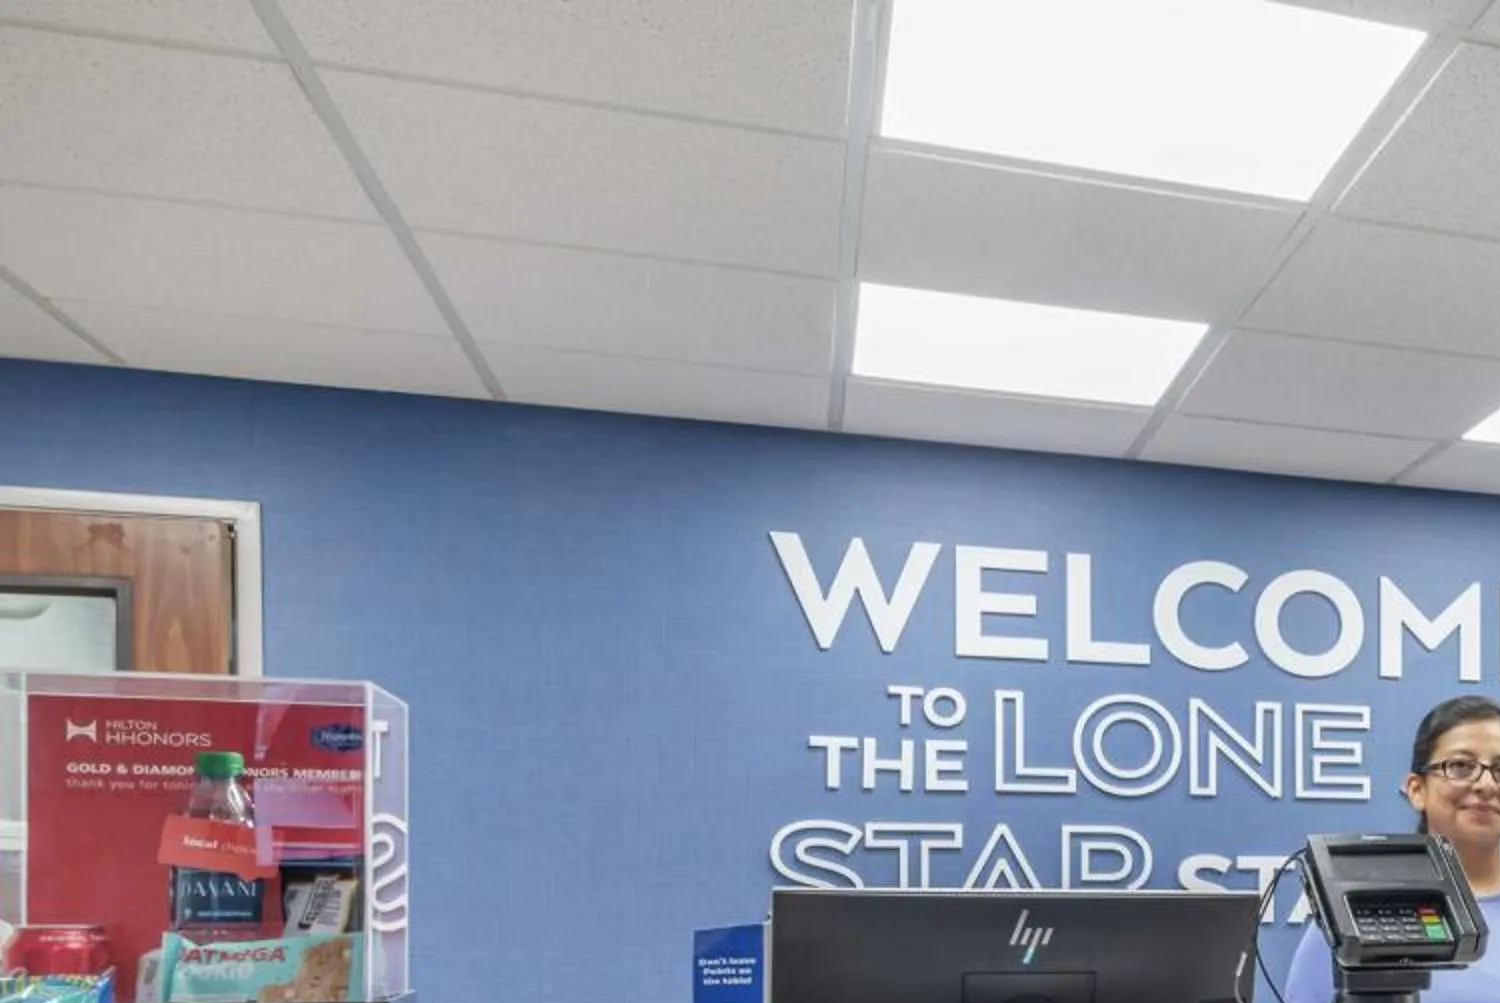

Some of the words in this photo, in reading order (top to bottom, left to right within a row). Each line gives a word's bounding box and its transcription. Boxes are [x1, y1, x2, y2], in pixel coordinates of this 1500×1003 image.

[887, 685, 968, 728] TO
[105, 719, 158, 730] HILTON
[105, 731, 213, 748] HHONORS
[808, 735, 969, 793] THE
[993, 688, 1372, 801] LONE
[66, 762, 112, 775] GOLD
[116, 763, 129, 775] &
[180, 879, 258, 897] DASANI
